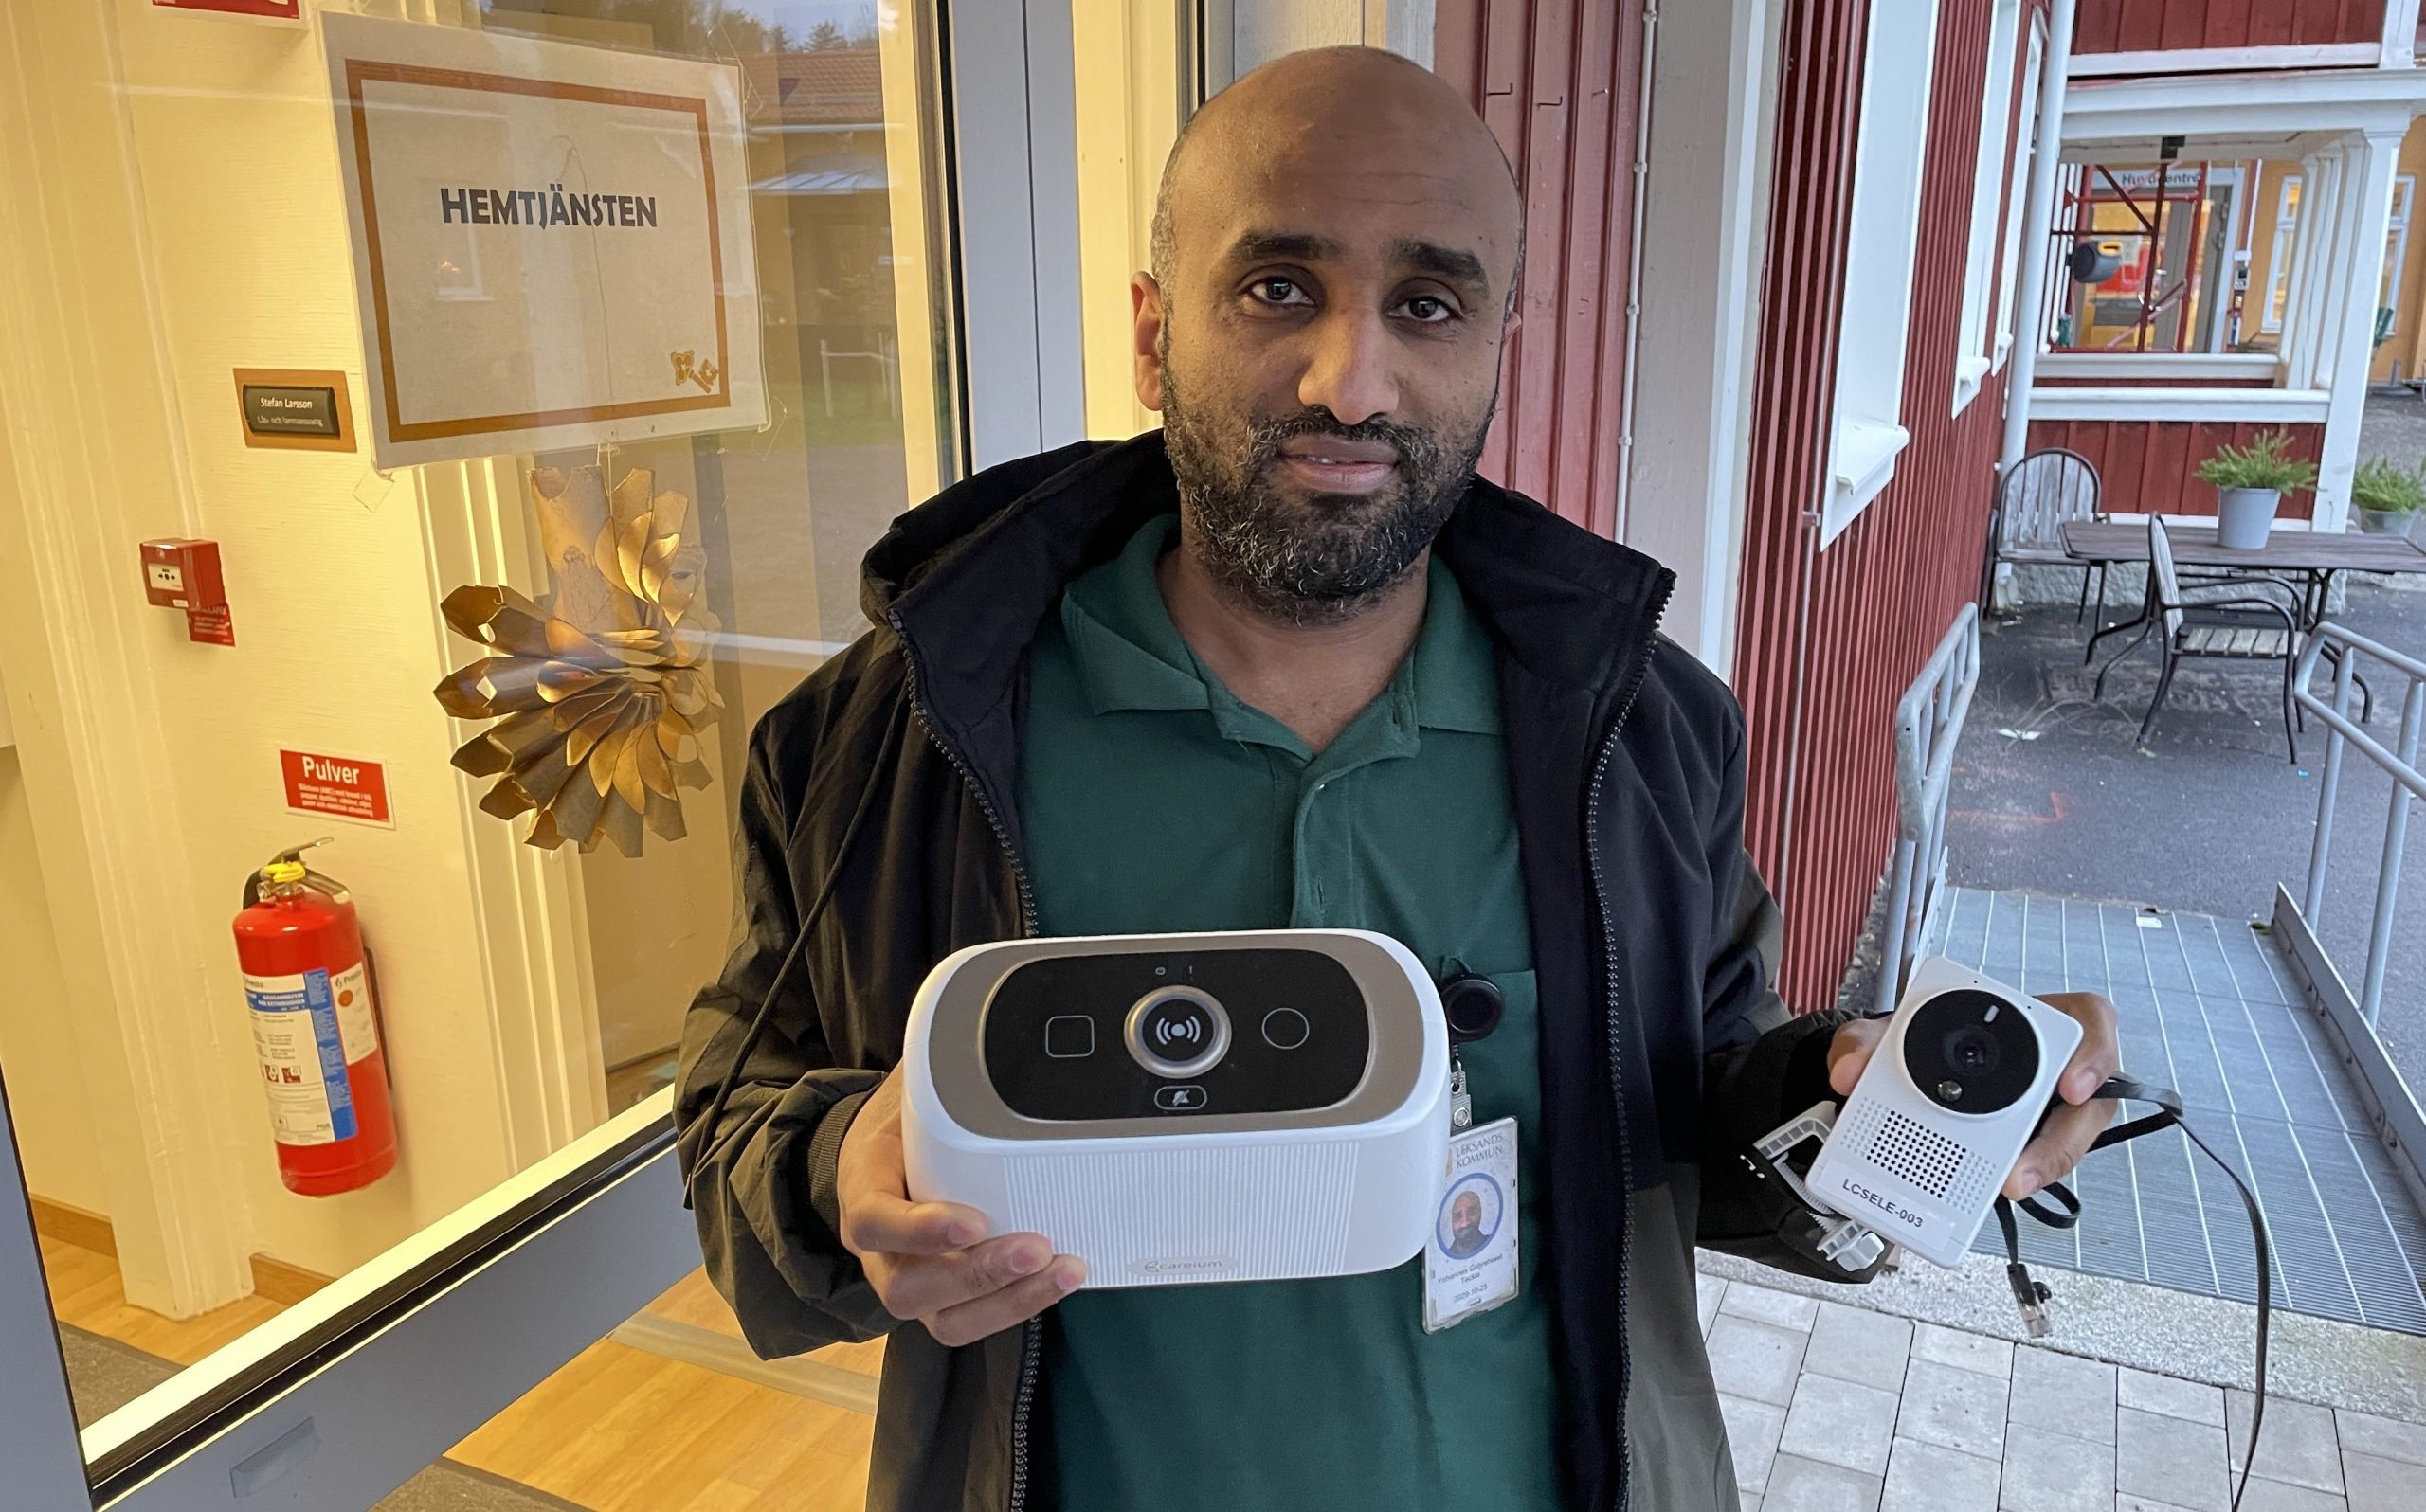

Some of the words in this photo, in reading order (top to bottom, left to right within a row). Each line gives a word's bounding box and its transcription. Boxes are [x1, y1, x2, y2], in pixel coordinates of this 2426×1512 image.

[440, 183, 658, 230] HEMTJÄNSTEN
[260, 397, 283, 408] Stefan
[284, 398, 313, 409] Larsson
[301, 755, 359, 785] Pulver
[1456, 1132, 1504, 1158] LEKSANDS
[1456, 1145, 1503, 1170] KOMMUN
[1842, 1179, 1924, 1228] LCSELE-003
[1159, 1260, 1222, 1271] careium
